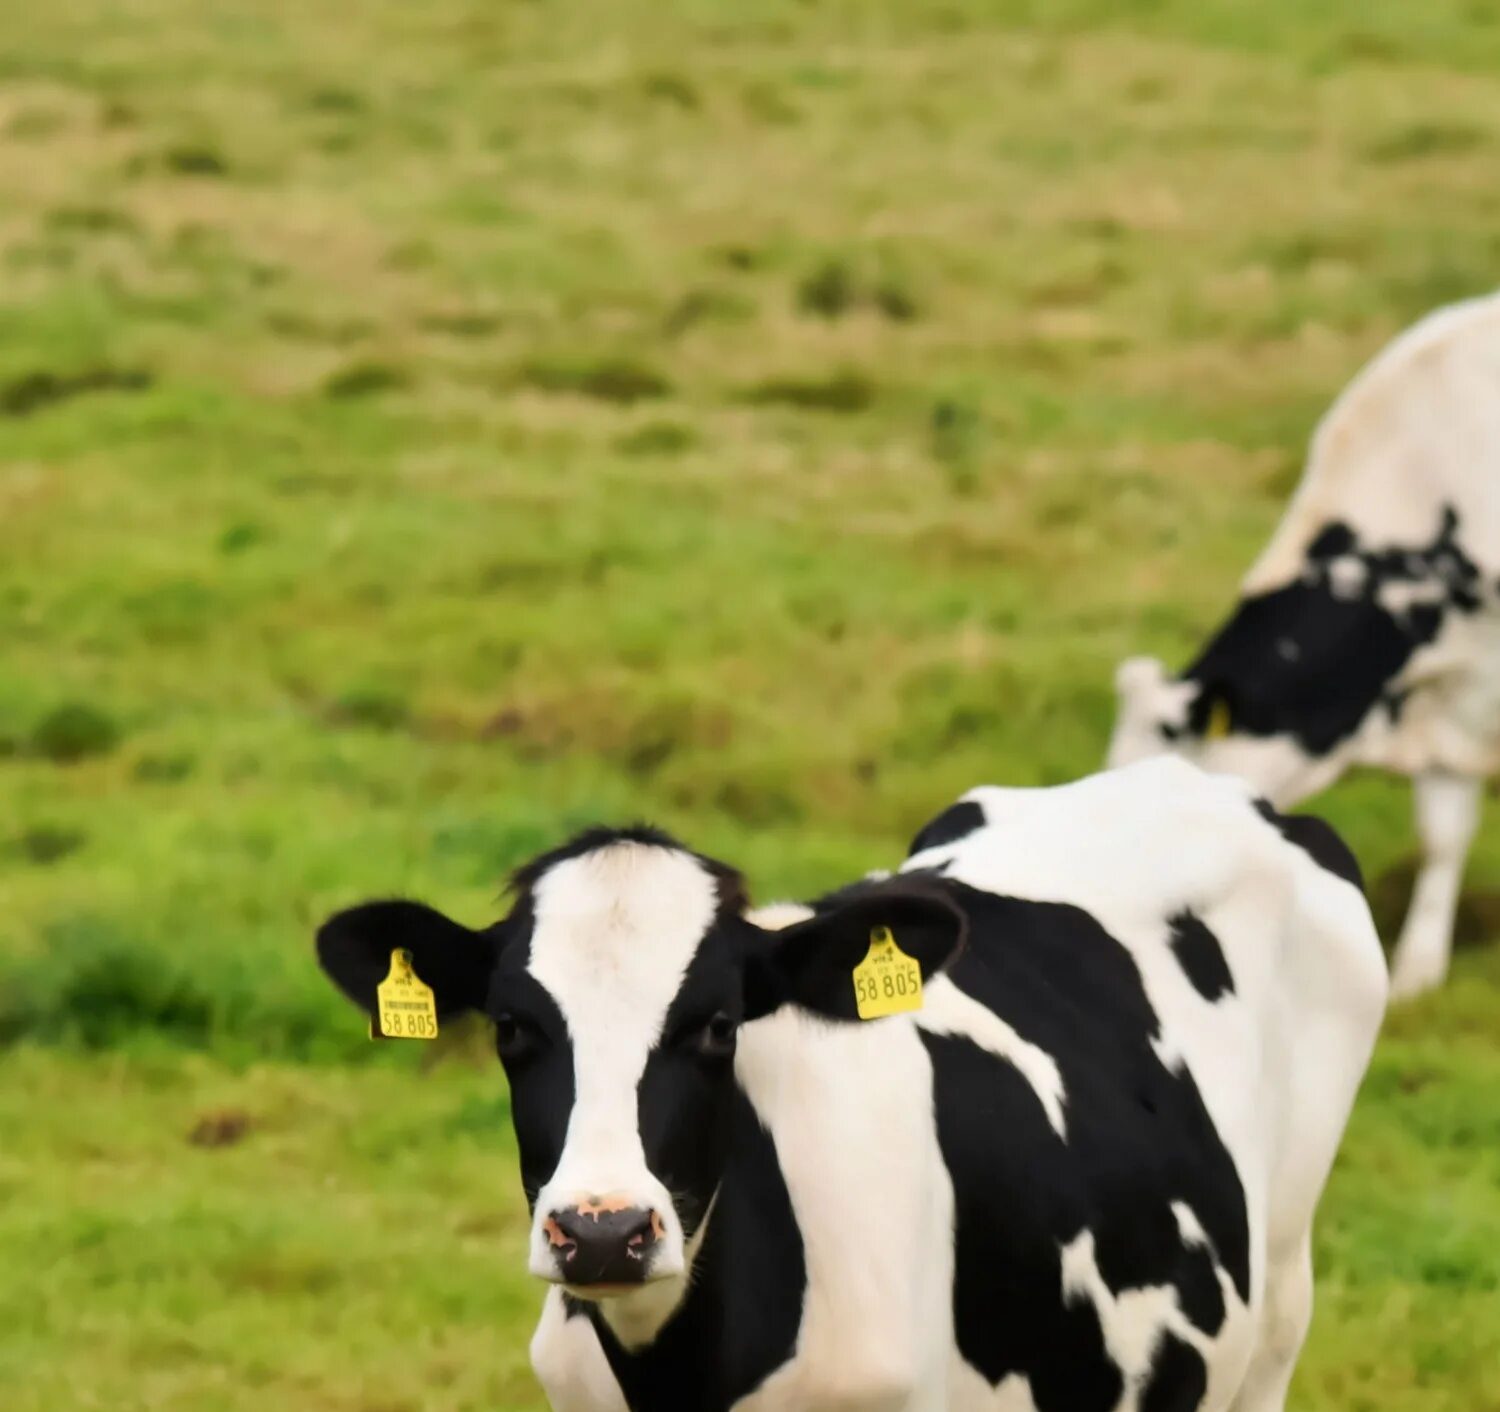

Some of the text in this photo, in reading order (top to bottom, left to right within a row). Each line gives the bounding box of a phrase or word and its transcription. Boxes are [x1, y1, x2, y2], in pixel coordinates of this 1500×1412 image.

[859, 971, 918, 1003] 58 805
[384, 1012, 435, 1036] 58 805
